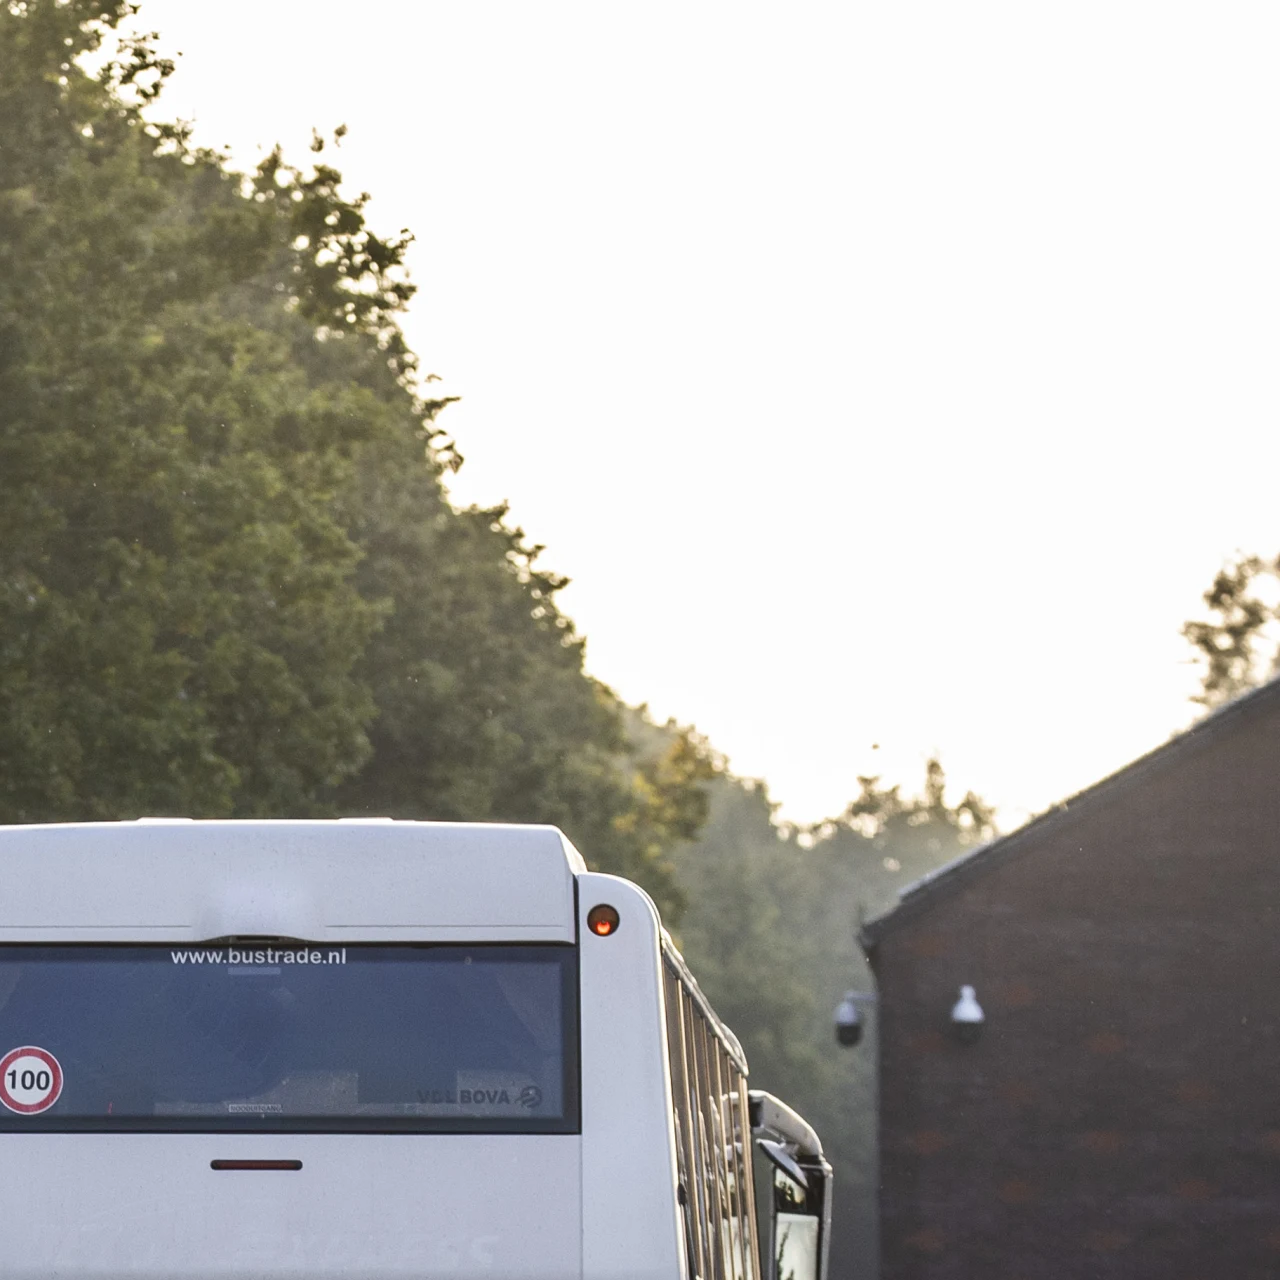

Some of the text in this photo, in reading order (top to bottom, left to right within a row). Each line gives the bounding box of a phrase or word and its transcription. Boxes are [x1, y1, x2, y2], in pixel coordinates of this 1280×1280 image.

[171, 948, 347, 965] www.bustrade.nl
[7, 1069, 50, 1091] 100
[459, 1089, 510, 1104] BOVA
